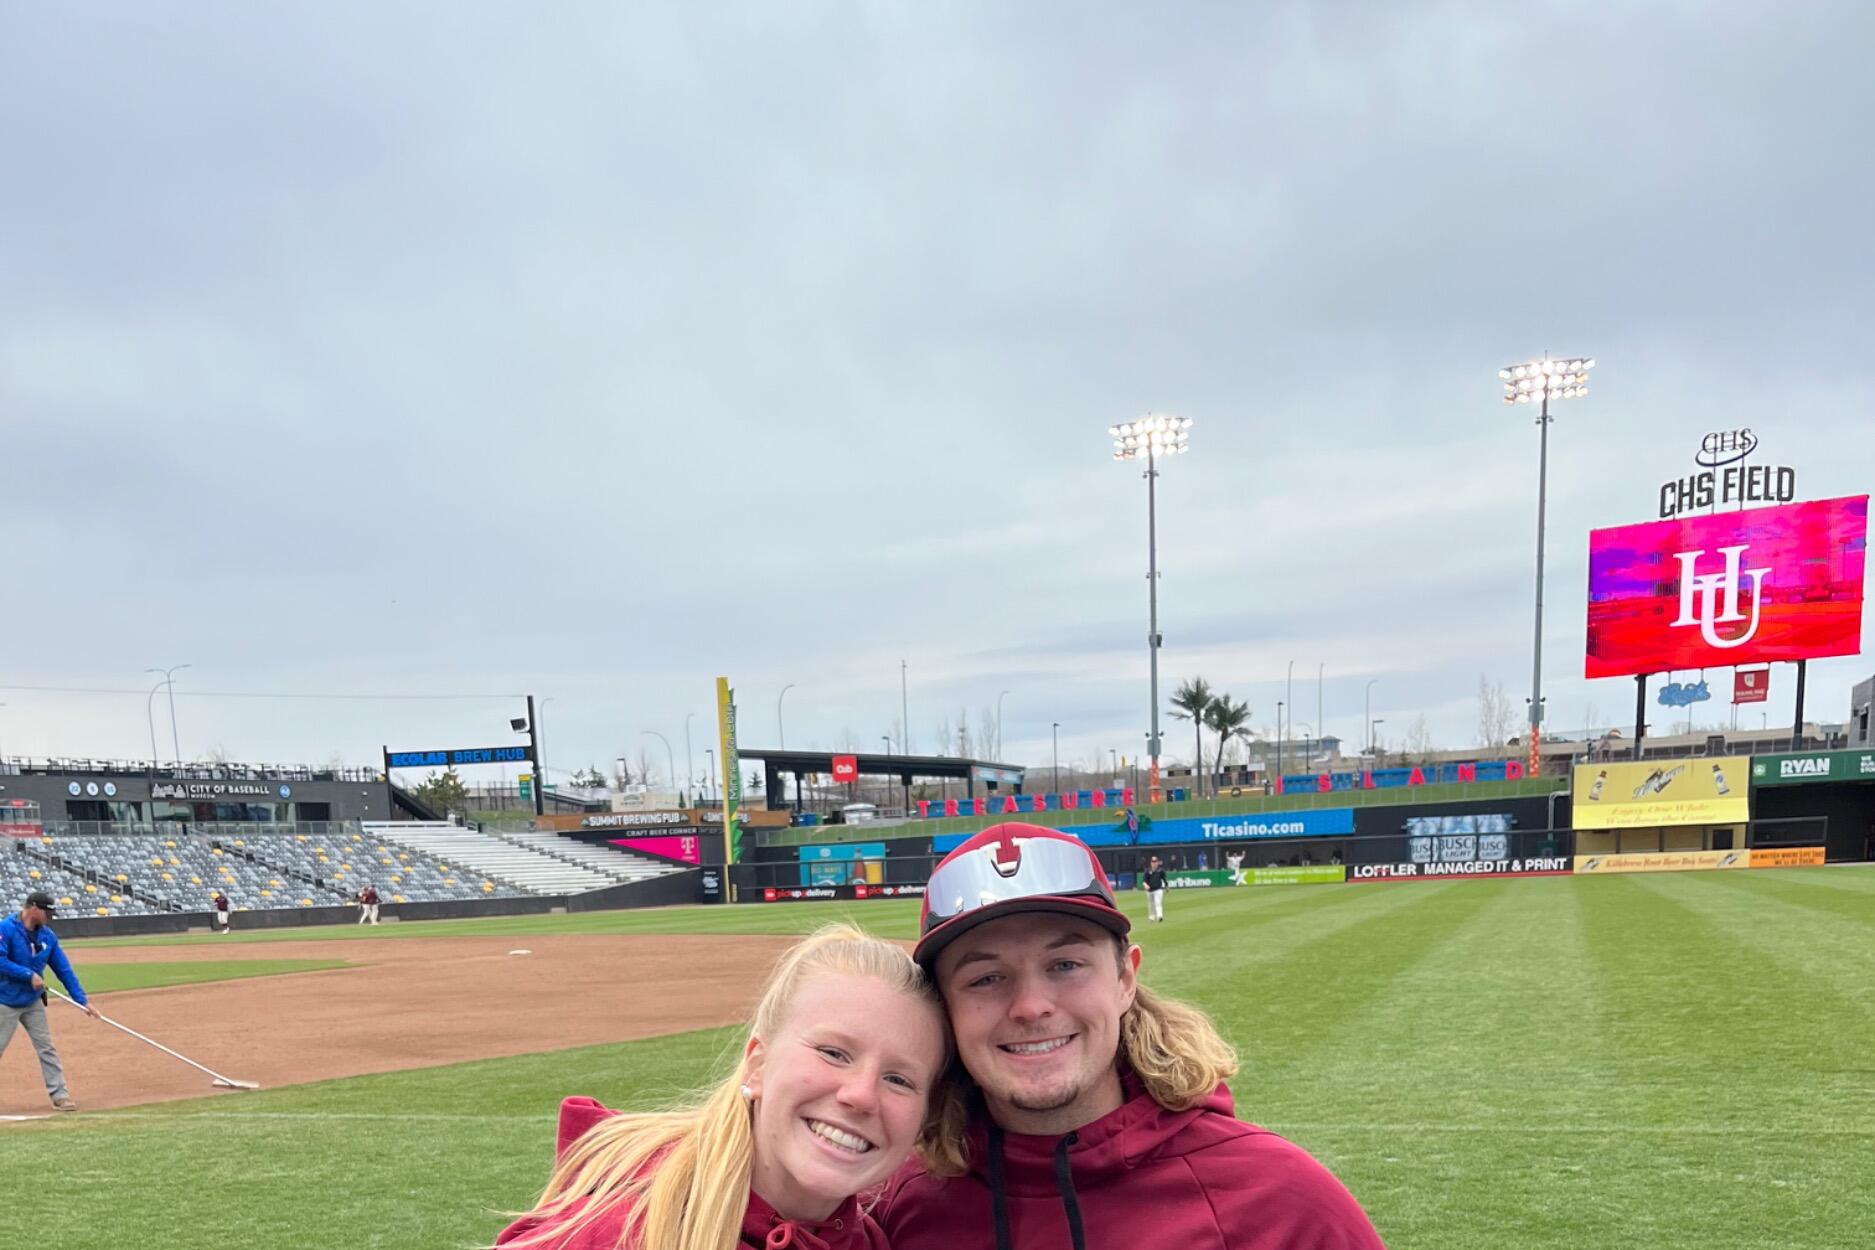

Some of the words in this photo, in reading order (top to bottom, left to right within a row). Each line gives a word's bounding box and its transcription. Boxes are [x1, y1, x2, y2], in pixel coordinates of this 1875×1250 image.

[1701, 428, 1753, 454] CHS
[1660, 471, 1715, 518] CHS
[1722, 466, 1795, 504] FIELD
[391, 752, 449, 766] ECOLAB
[454, 750, 492, 763] BREW
[495, 748, 526, 761] HUB
[1780, 758, 1830, 775] RYAN
[190, 785, 211, 793] CITY
[213, 784, 225, 793] OF
[228, 785, 270, 795] BASEBALL
[589, 814, 622, 827] SUMMIT
[623, 813, 661, 825] BREWING
[661, 812, 680, 823] PUB
[626, 829, 648, 837] CRAFT
[669, 828, 697, 836] CORNER
[1354, 863, 1417, 878] LOFFLER
[1424, 861, 1494, 875] MANAGED
[1497, 860, 1510, 872] IT
[1511, 859, 1522, 872] &
[1525, 857, 1568, 871] PRINT
[1165, 878, 1212, 888] arTribune
